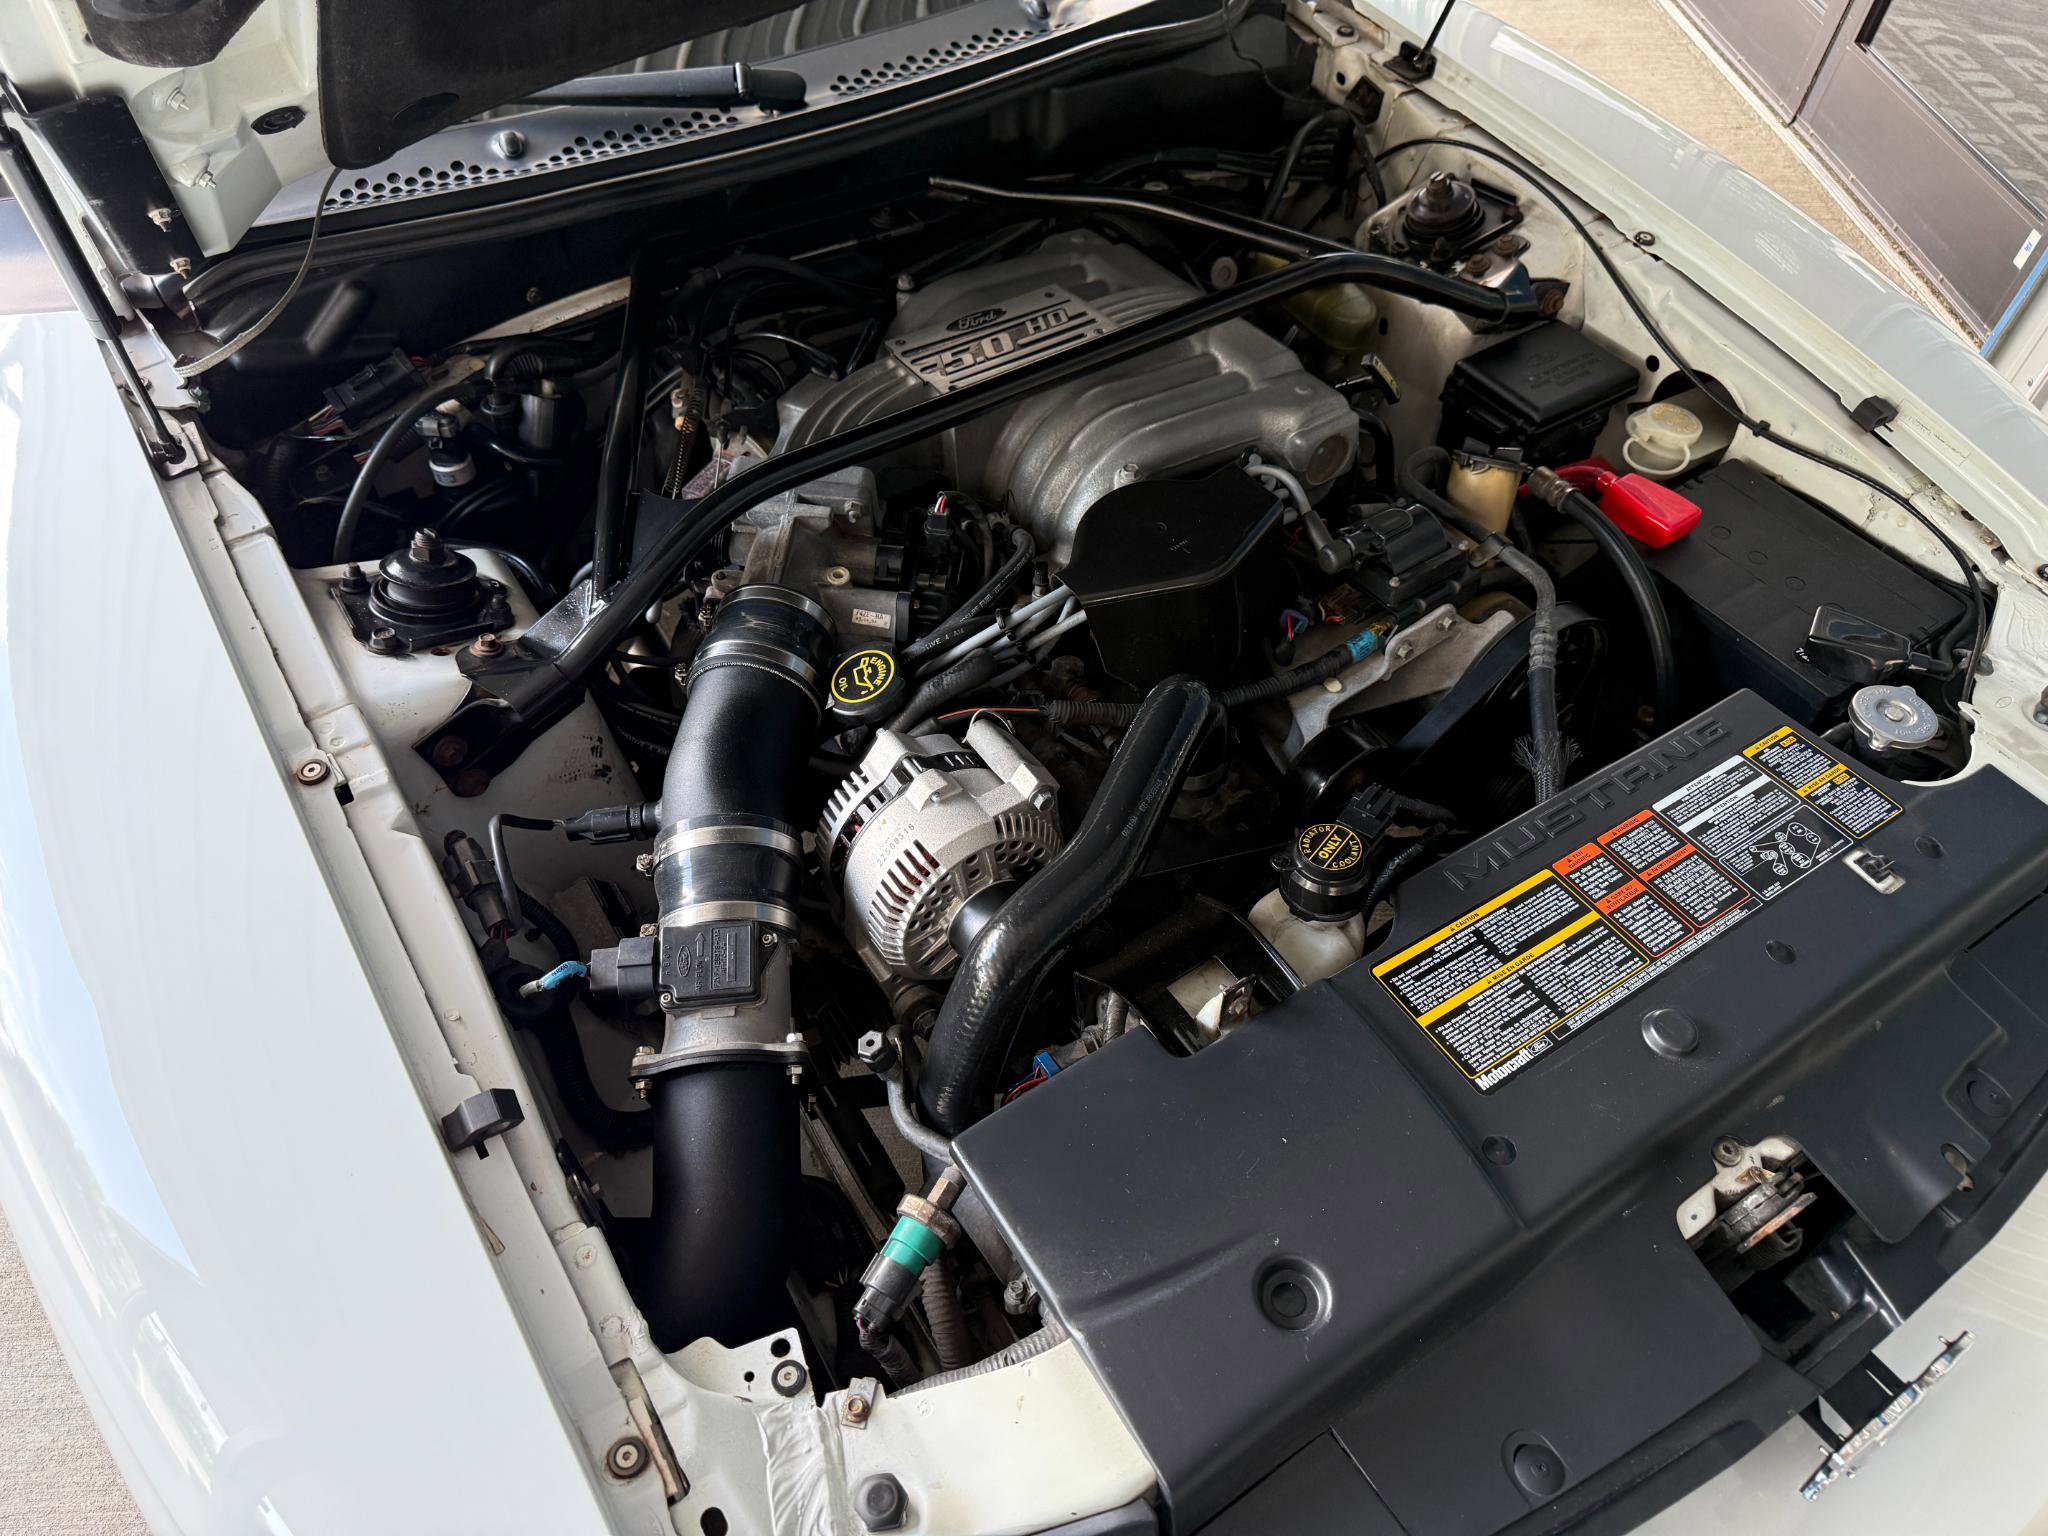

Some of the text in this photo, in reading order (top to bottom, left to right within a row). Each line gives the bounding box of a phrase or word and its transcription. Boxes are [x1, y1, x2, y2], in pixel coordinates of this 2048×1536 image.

[957, 312, 998, 330] Ford
[940, 332, 1015, 376] 5.0
[870, 656, 887, 686] ENGINE
[838, 677, 849, 692] OIL
[1685, 775, 1712, 791] ATTENTION
[1825, 768, 1841, 778] GARDE
[1443, 716, 1733, 890] MUSTANG
[1616, 818, 1639, 833] WARNING
[1301, 825, 1332, 854] RADIATOR
[1318, 834, 1343, 859] ONLY
[1332, 839, 1360, 868] COOLANT
[1567, 853, 1591, 868] WARNING
[1651, 849, 1689, 873] AVERTISSEMENT
[1455, 913, 1479, 928] CAUTION
[1492, 970, 1507, 981] MISE
[1515, 953, 1535, 967] GARDE
[1474, 1047, 1534, 1091] Motorcraft
